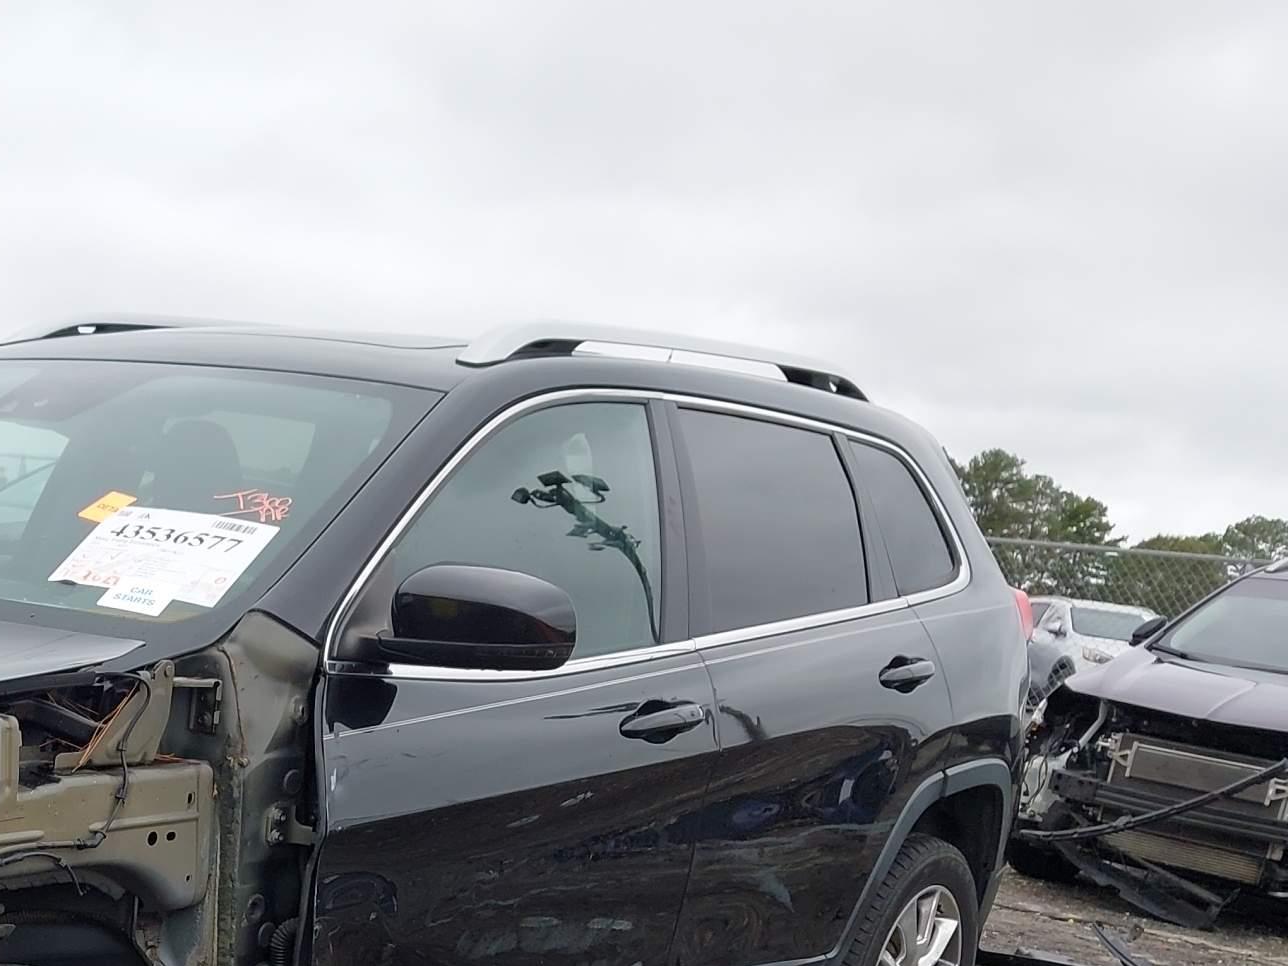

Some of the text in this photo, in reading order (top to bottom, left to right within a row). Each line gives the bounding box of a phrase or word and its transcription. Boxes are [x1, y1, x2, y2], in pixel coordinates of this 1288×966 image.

[110, 523, 245, 553] 43536577
[130, 586, 154, 596] CAR
[113, 593, 157, 606] STARTS
